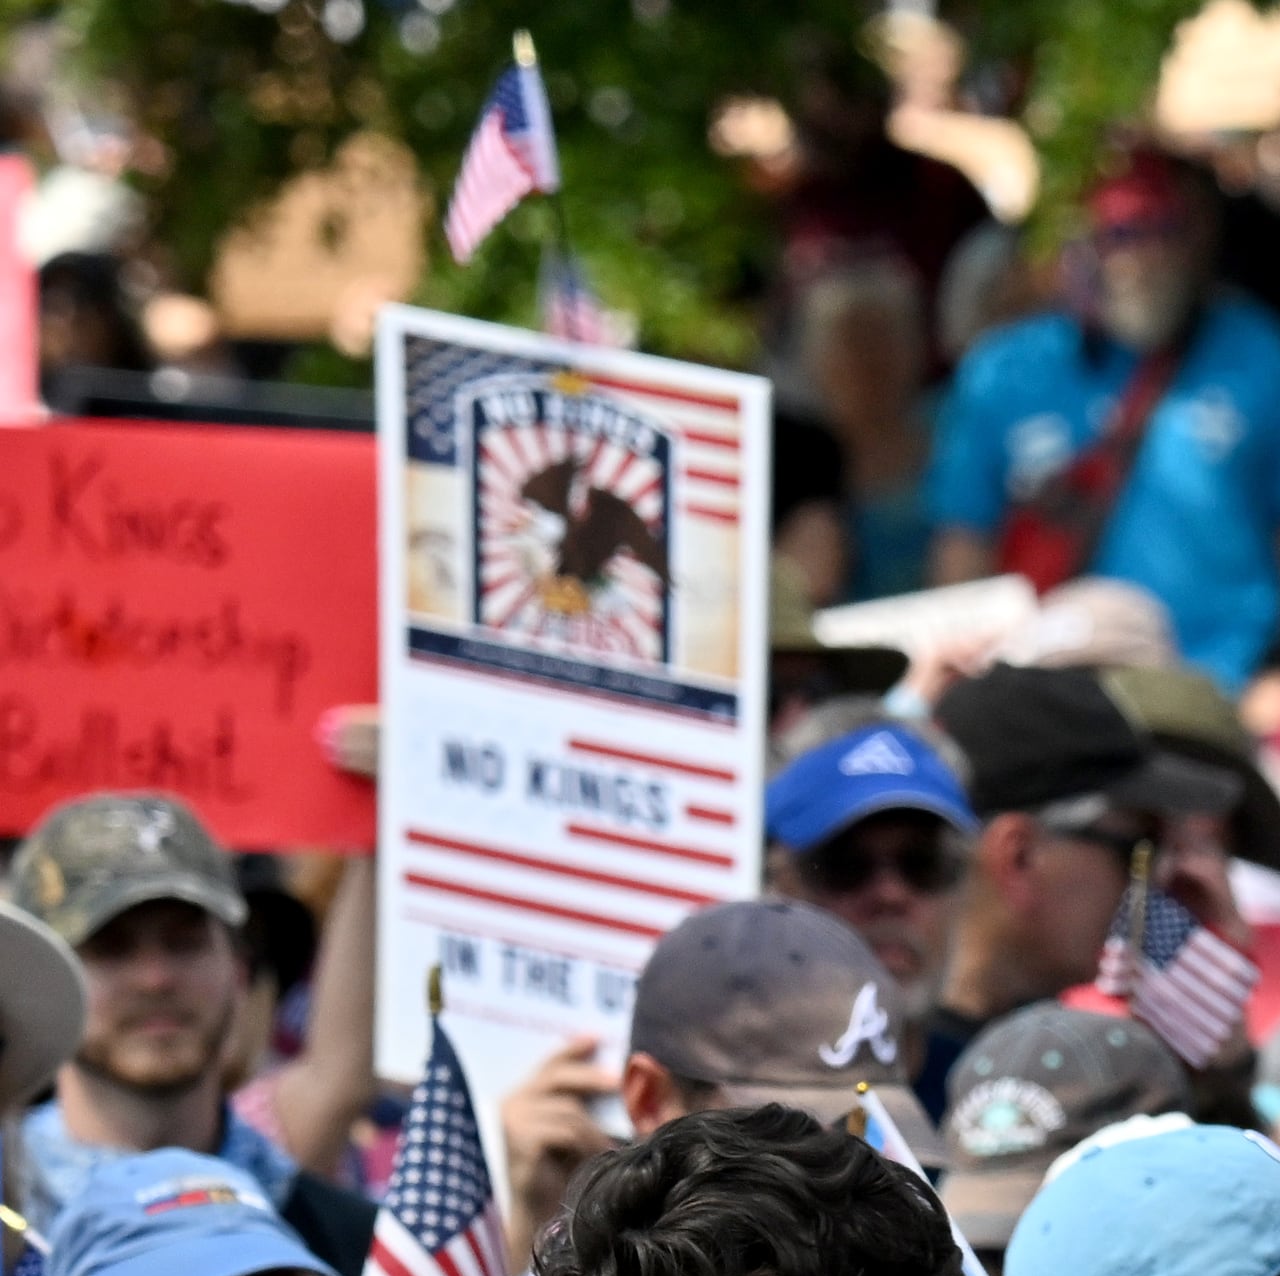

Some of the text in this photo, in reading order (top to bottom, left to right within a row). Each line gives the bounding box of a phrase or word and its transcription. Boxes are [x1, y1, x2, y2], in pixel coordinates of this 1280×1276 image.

[440, 738, 674, 832] NO KINGS
[440, 936, 480, 977] IN
[499, 945, 571, 1004] THE
[818, 982, 897, 1068] A
